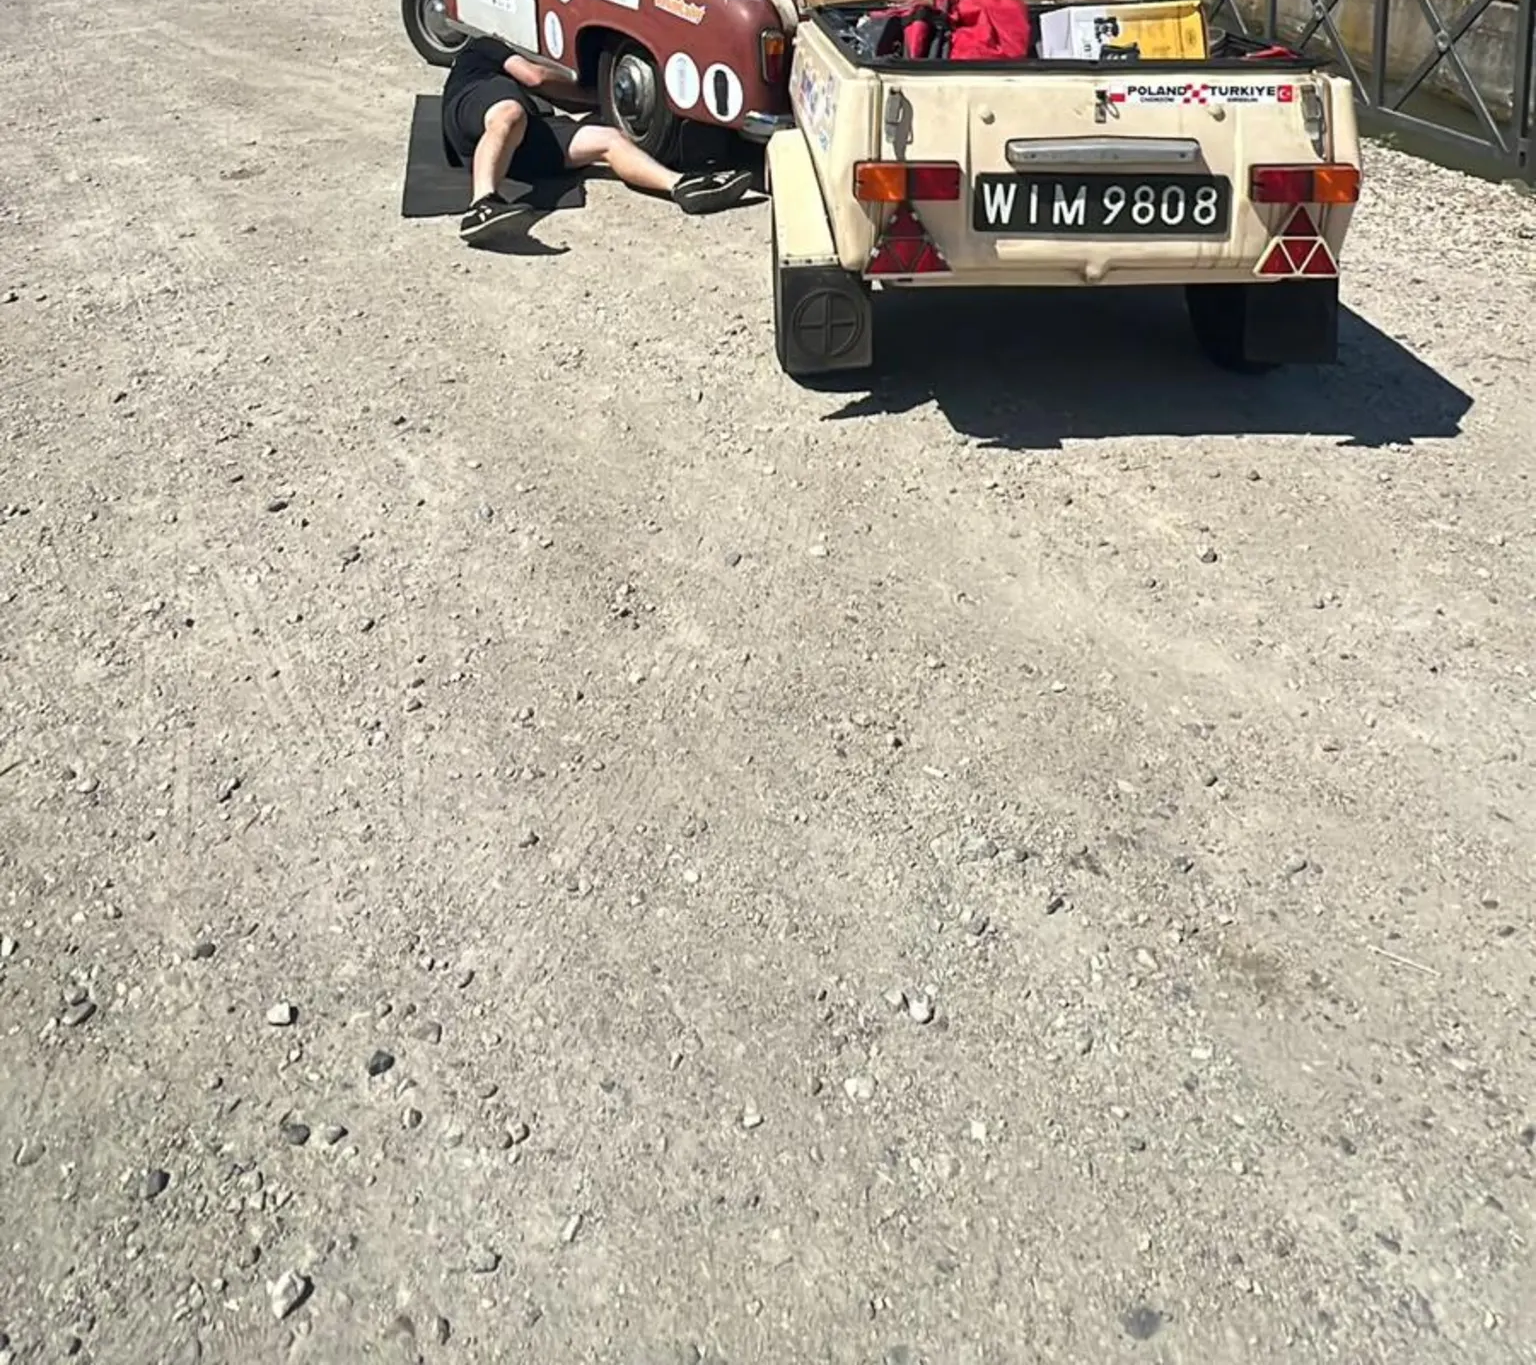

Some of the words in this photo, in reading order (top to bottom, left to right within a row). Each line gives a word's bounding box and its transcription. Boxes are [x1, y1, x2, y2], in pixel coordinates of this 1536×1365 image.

[1127, 86, 1187, 96] POLAND
[1210, 86, 1276, 96] TURKIYE
[983, 183, 1087, 225] WIM
[1102, 185, 1217, 225] 9808
